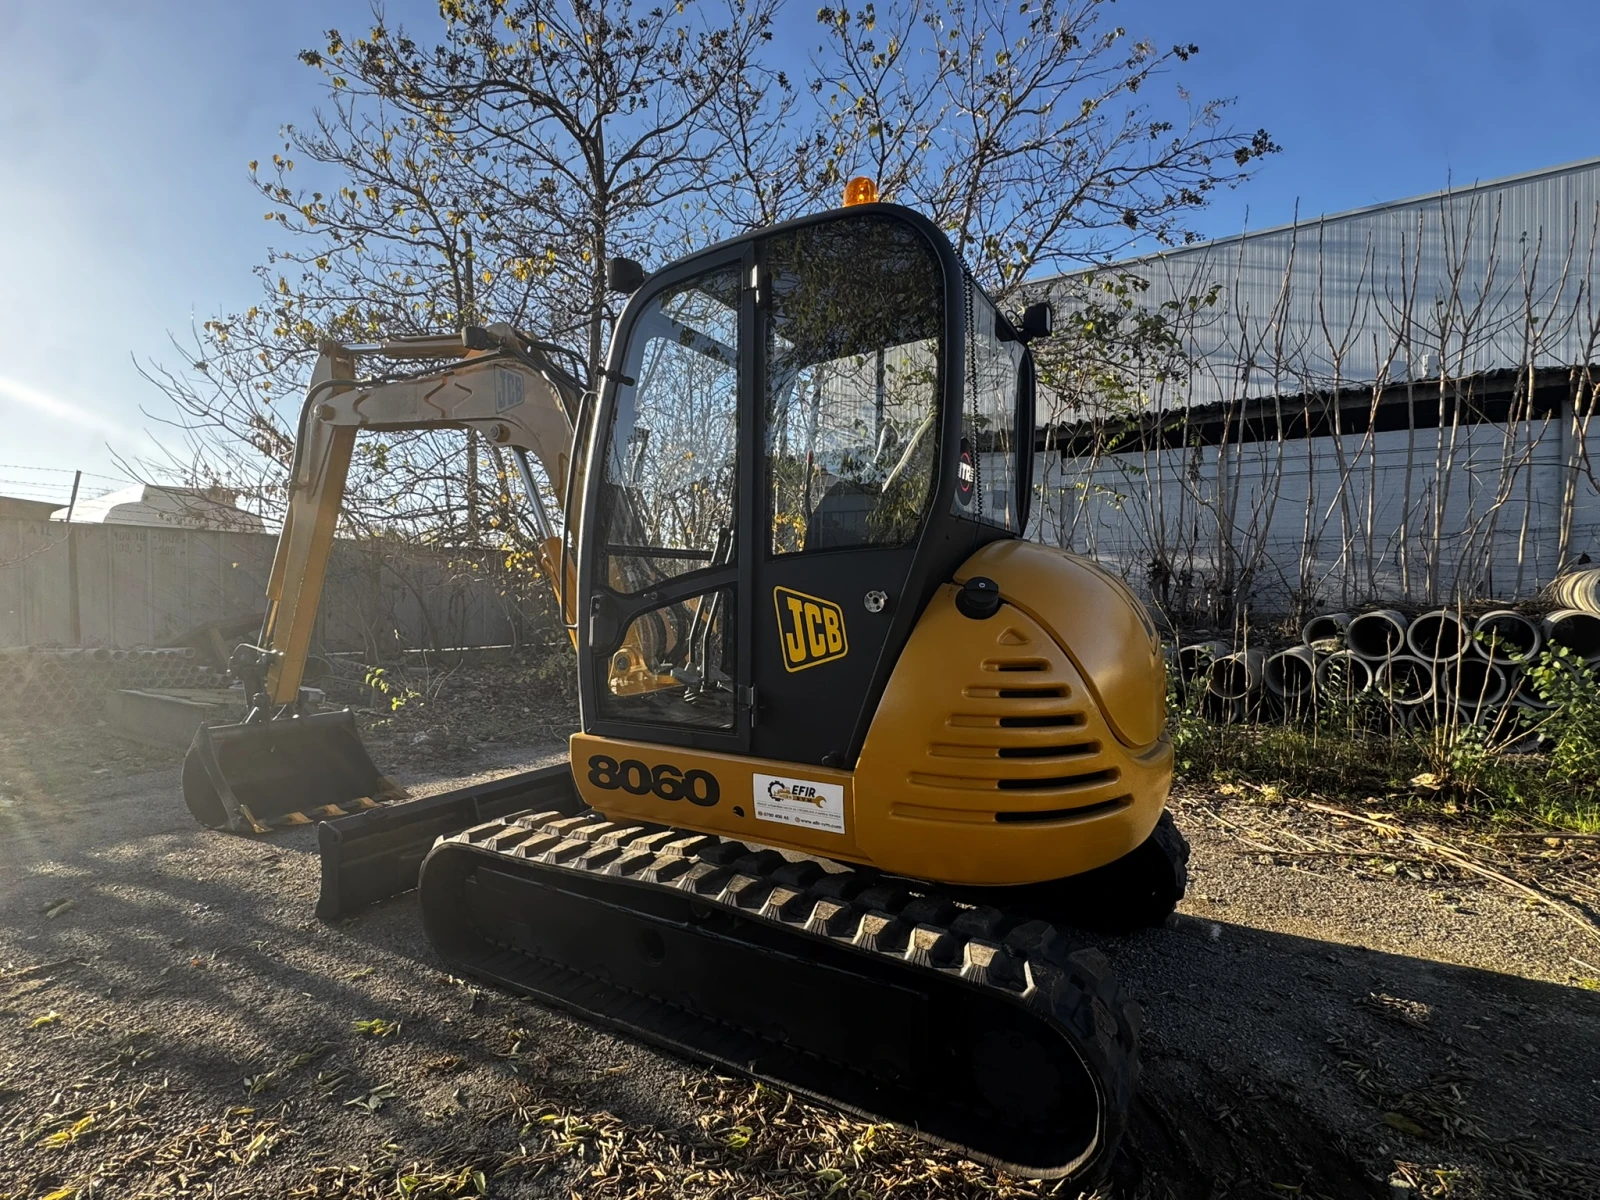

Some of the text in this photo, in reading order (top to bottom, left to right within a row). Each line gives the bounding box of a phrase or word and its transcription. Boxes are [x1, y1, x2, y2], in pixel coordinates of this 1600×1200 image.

[497, 370, 522, 409] JCB
[785, 596, 842, 663] JCB
[587, 755, 721, 807] 8060
[792, 785, 816, 798] EFIR
